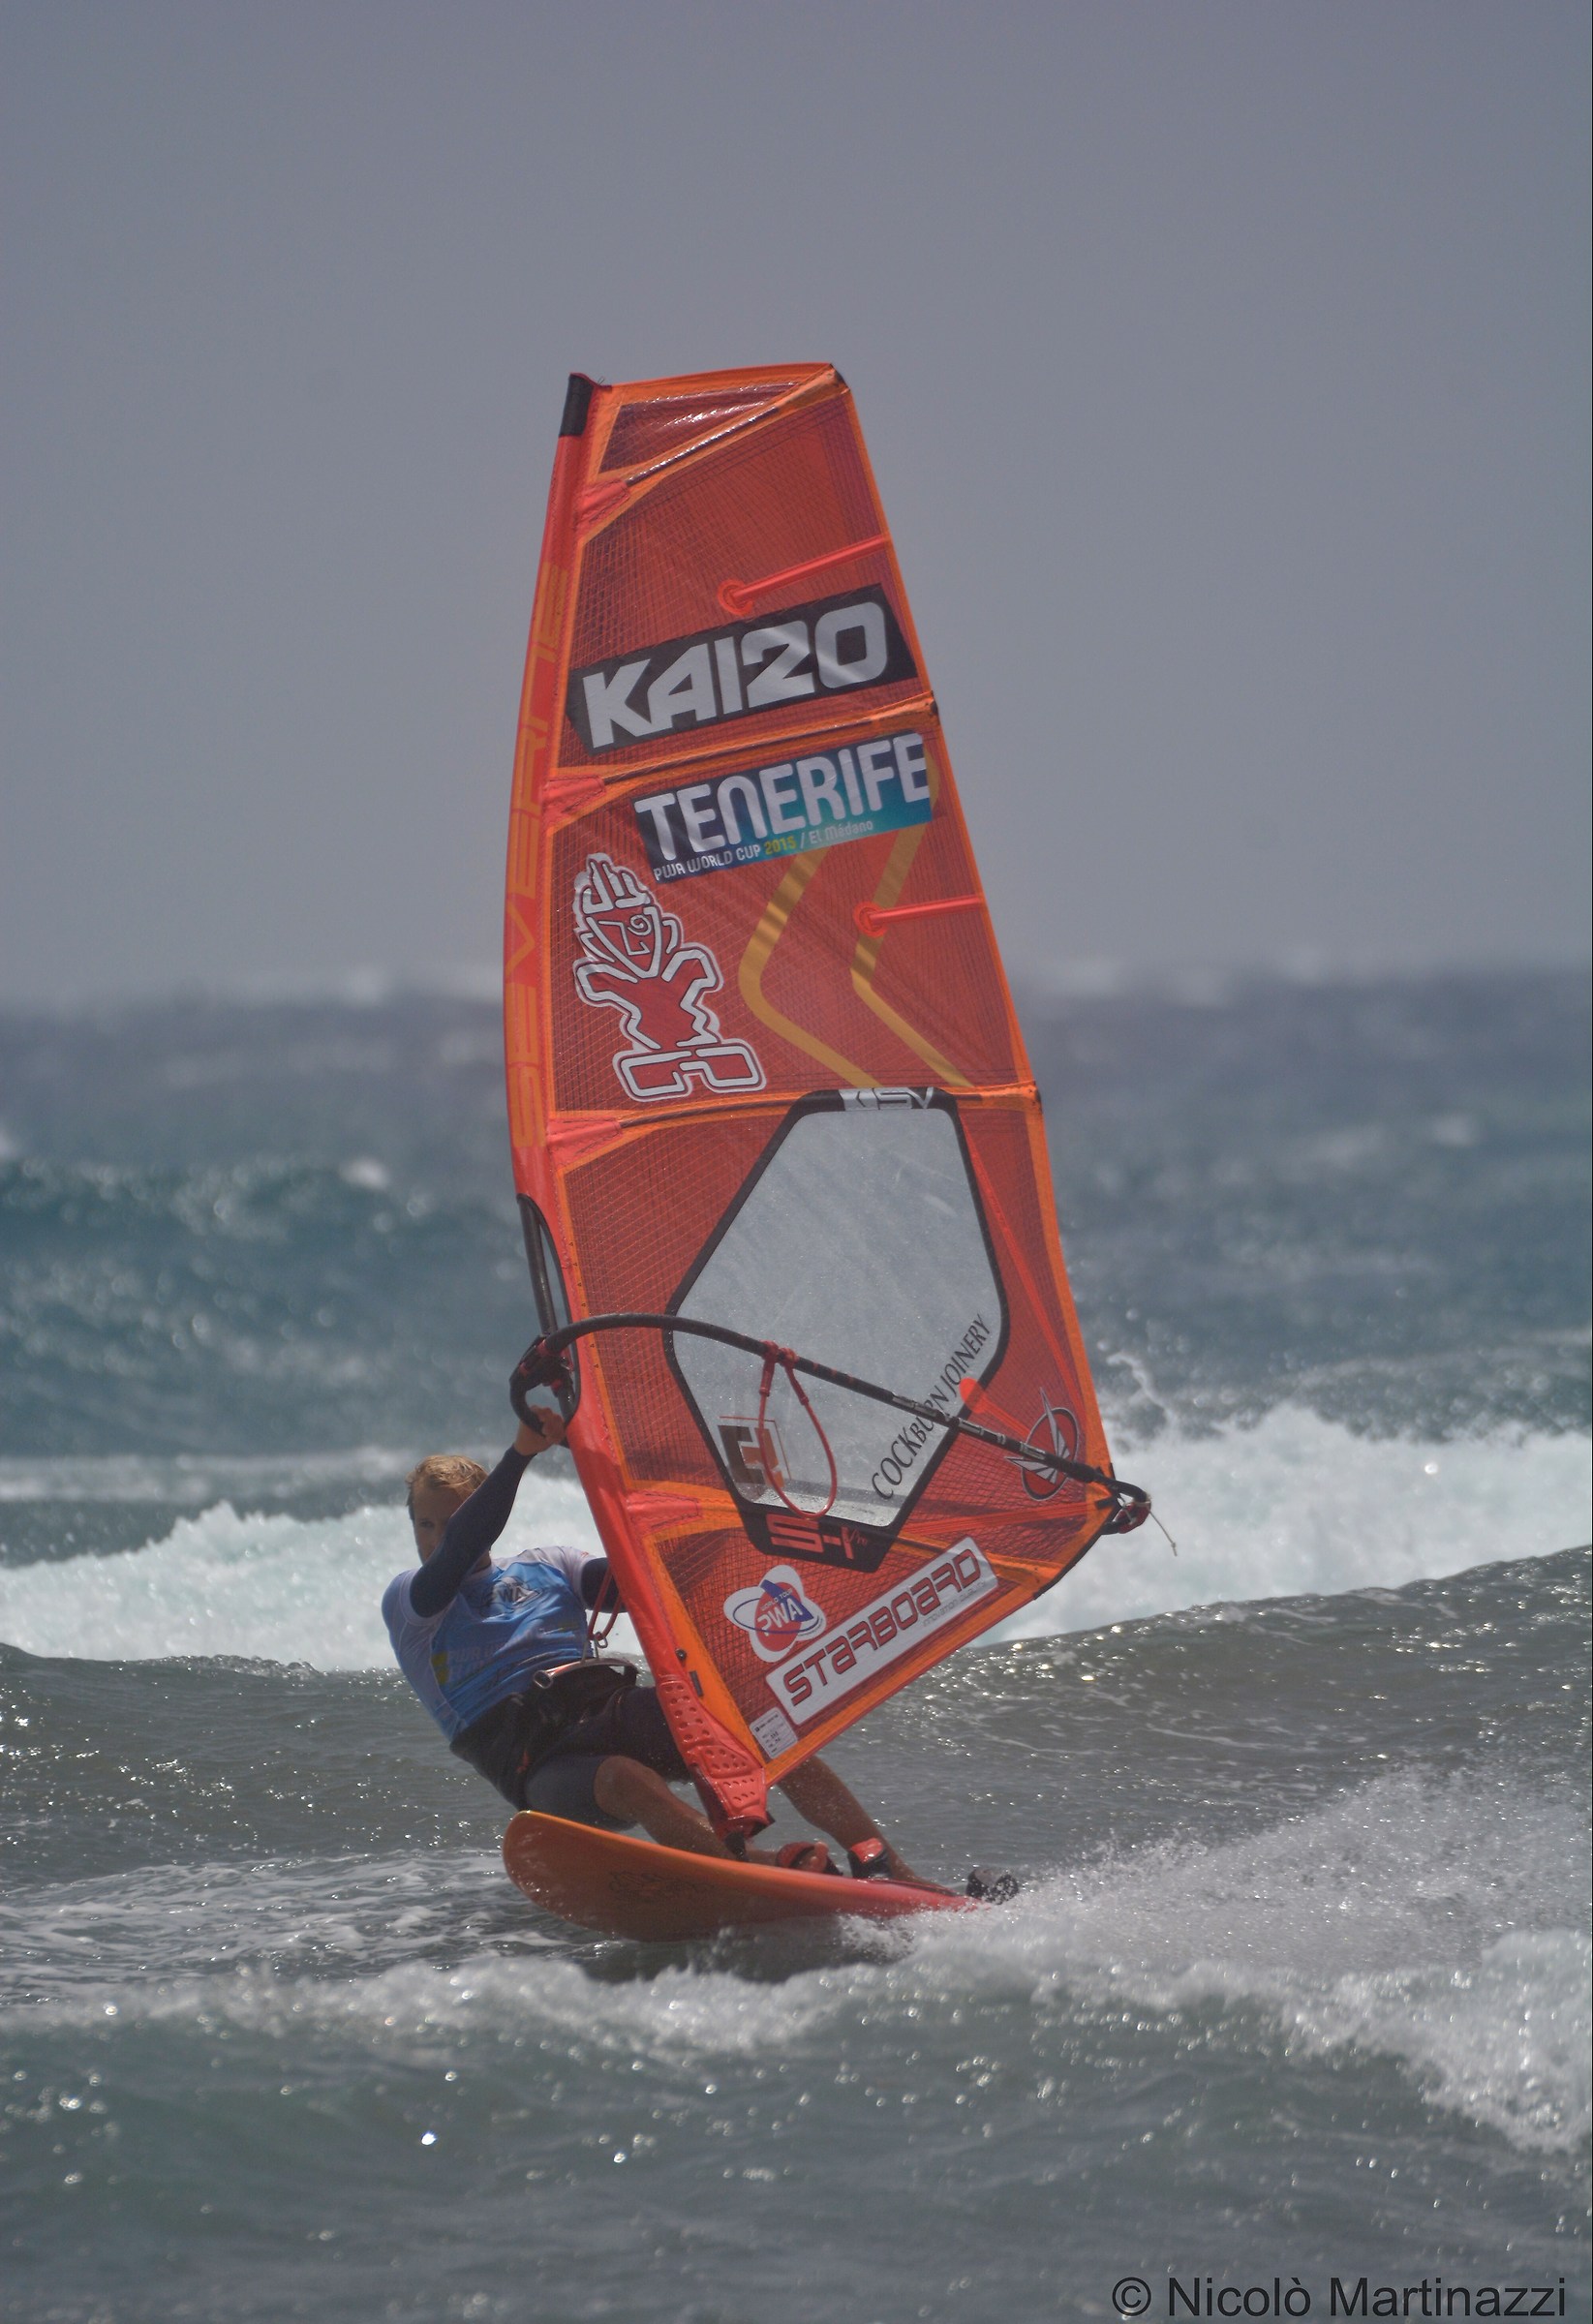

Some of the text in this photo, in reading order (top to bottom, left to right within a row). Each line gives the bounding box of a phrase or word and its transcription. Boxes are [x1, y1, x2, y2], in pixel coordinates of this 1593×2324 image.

[634, 732, 930, 861] TENERIFE
[653, 863, 686, 881] PWA
[689, 850, 733, 873] WORLD
[736, 843, 761, 861] CUP
[764, 837, 797, 856] 2015
[939, 1313, 991, 1398] JOINERY
[757, 1597, 804, 1637] PWA
